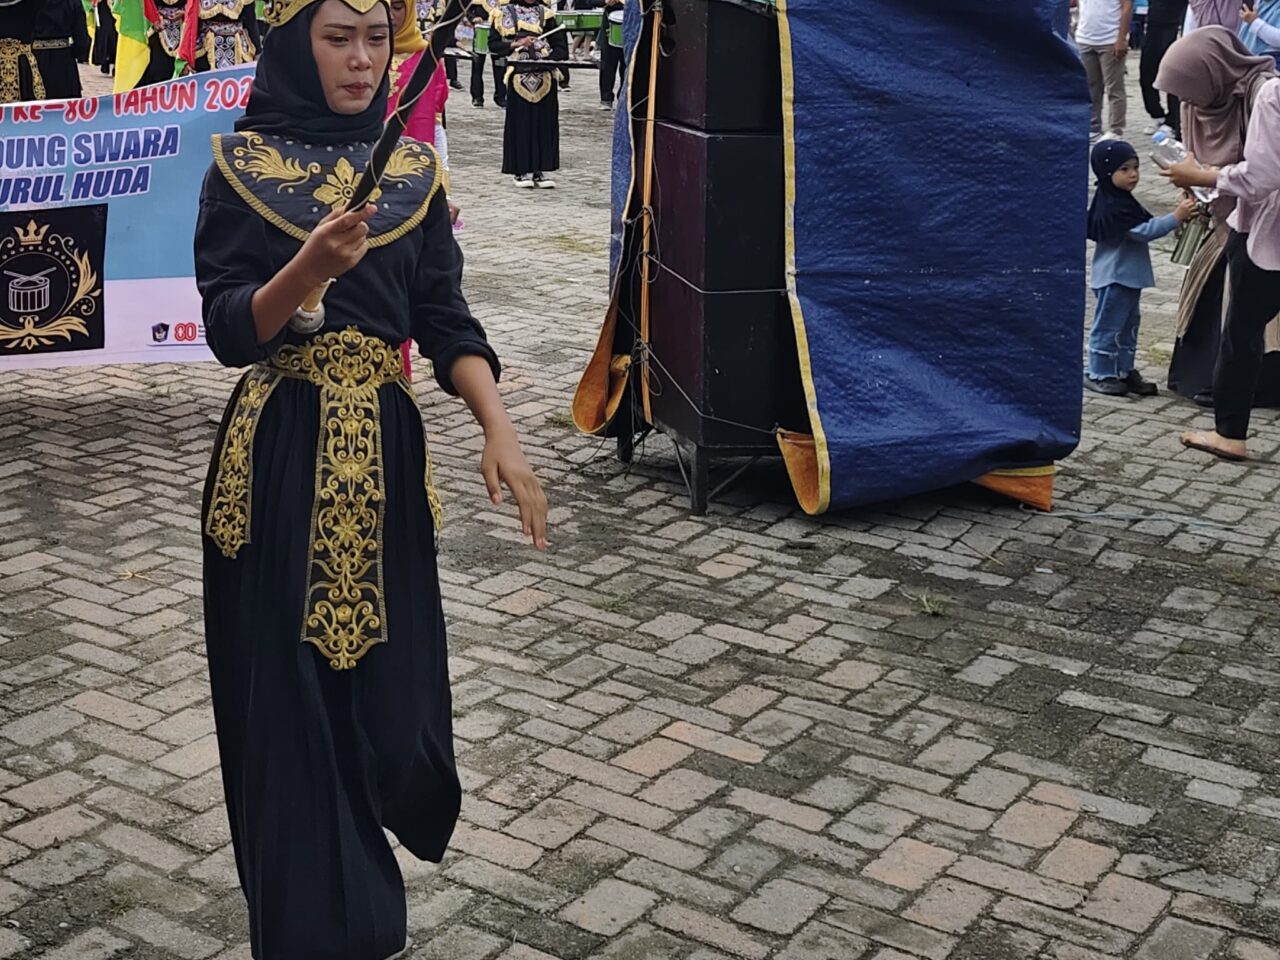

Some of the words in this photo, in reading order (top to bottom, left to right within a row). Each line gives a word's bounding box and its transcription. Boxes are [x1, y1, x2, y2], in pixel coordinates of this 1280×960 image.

[113, 80, 197, 116] TAHUN
[205, 77, 255, 111] 202
[74, 127, 179, 164] SWARA
[71, 166, 151, 200] HUDA
[175, 322, 197, 342] 80
